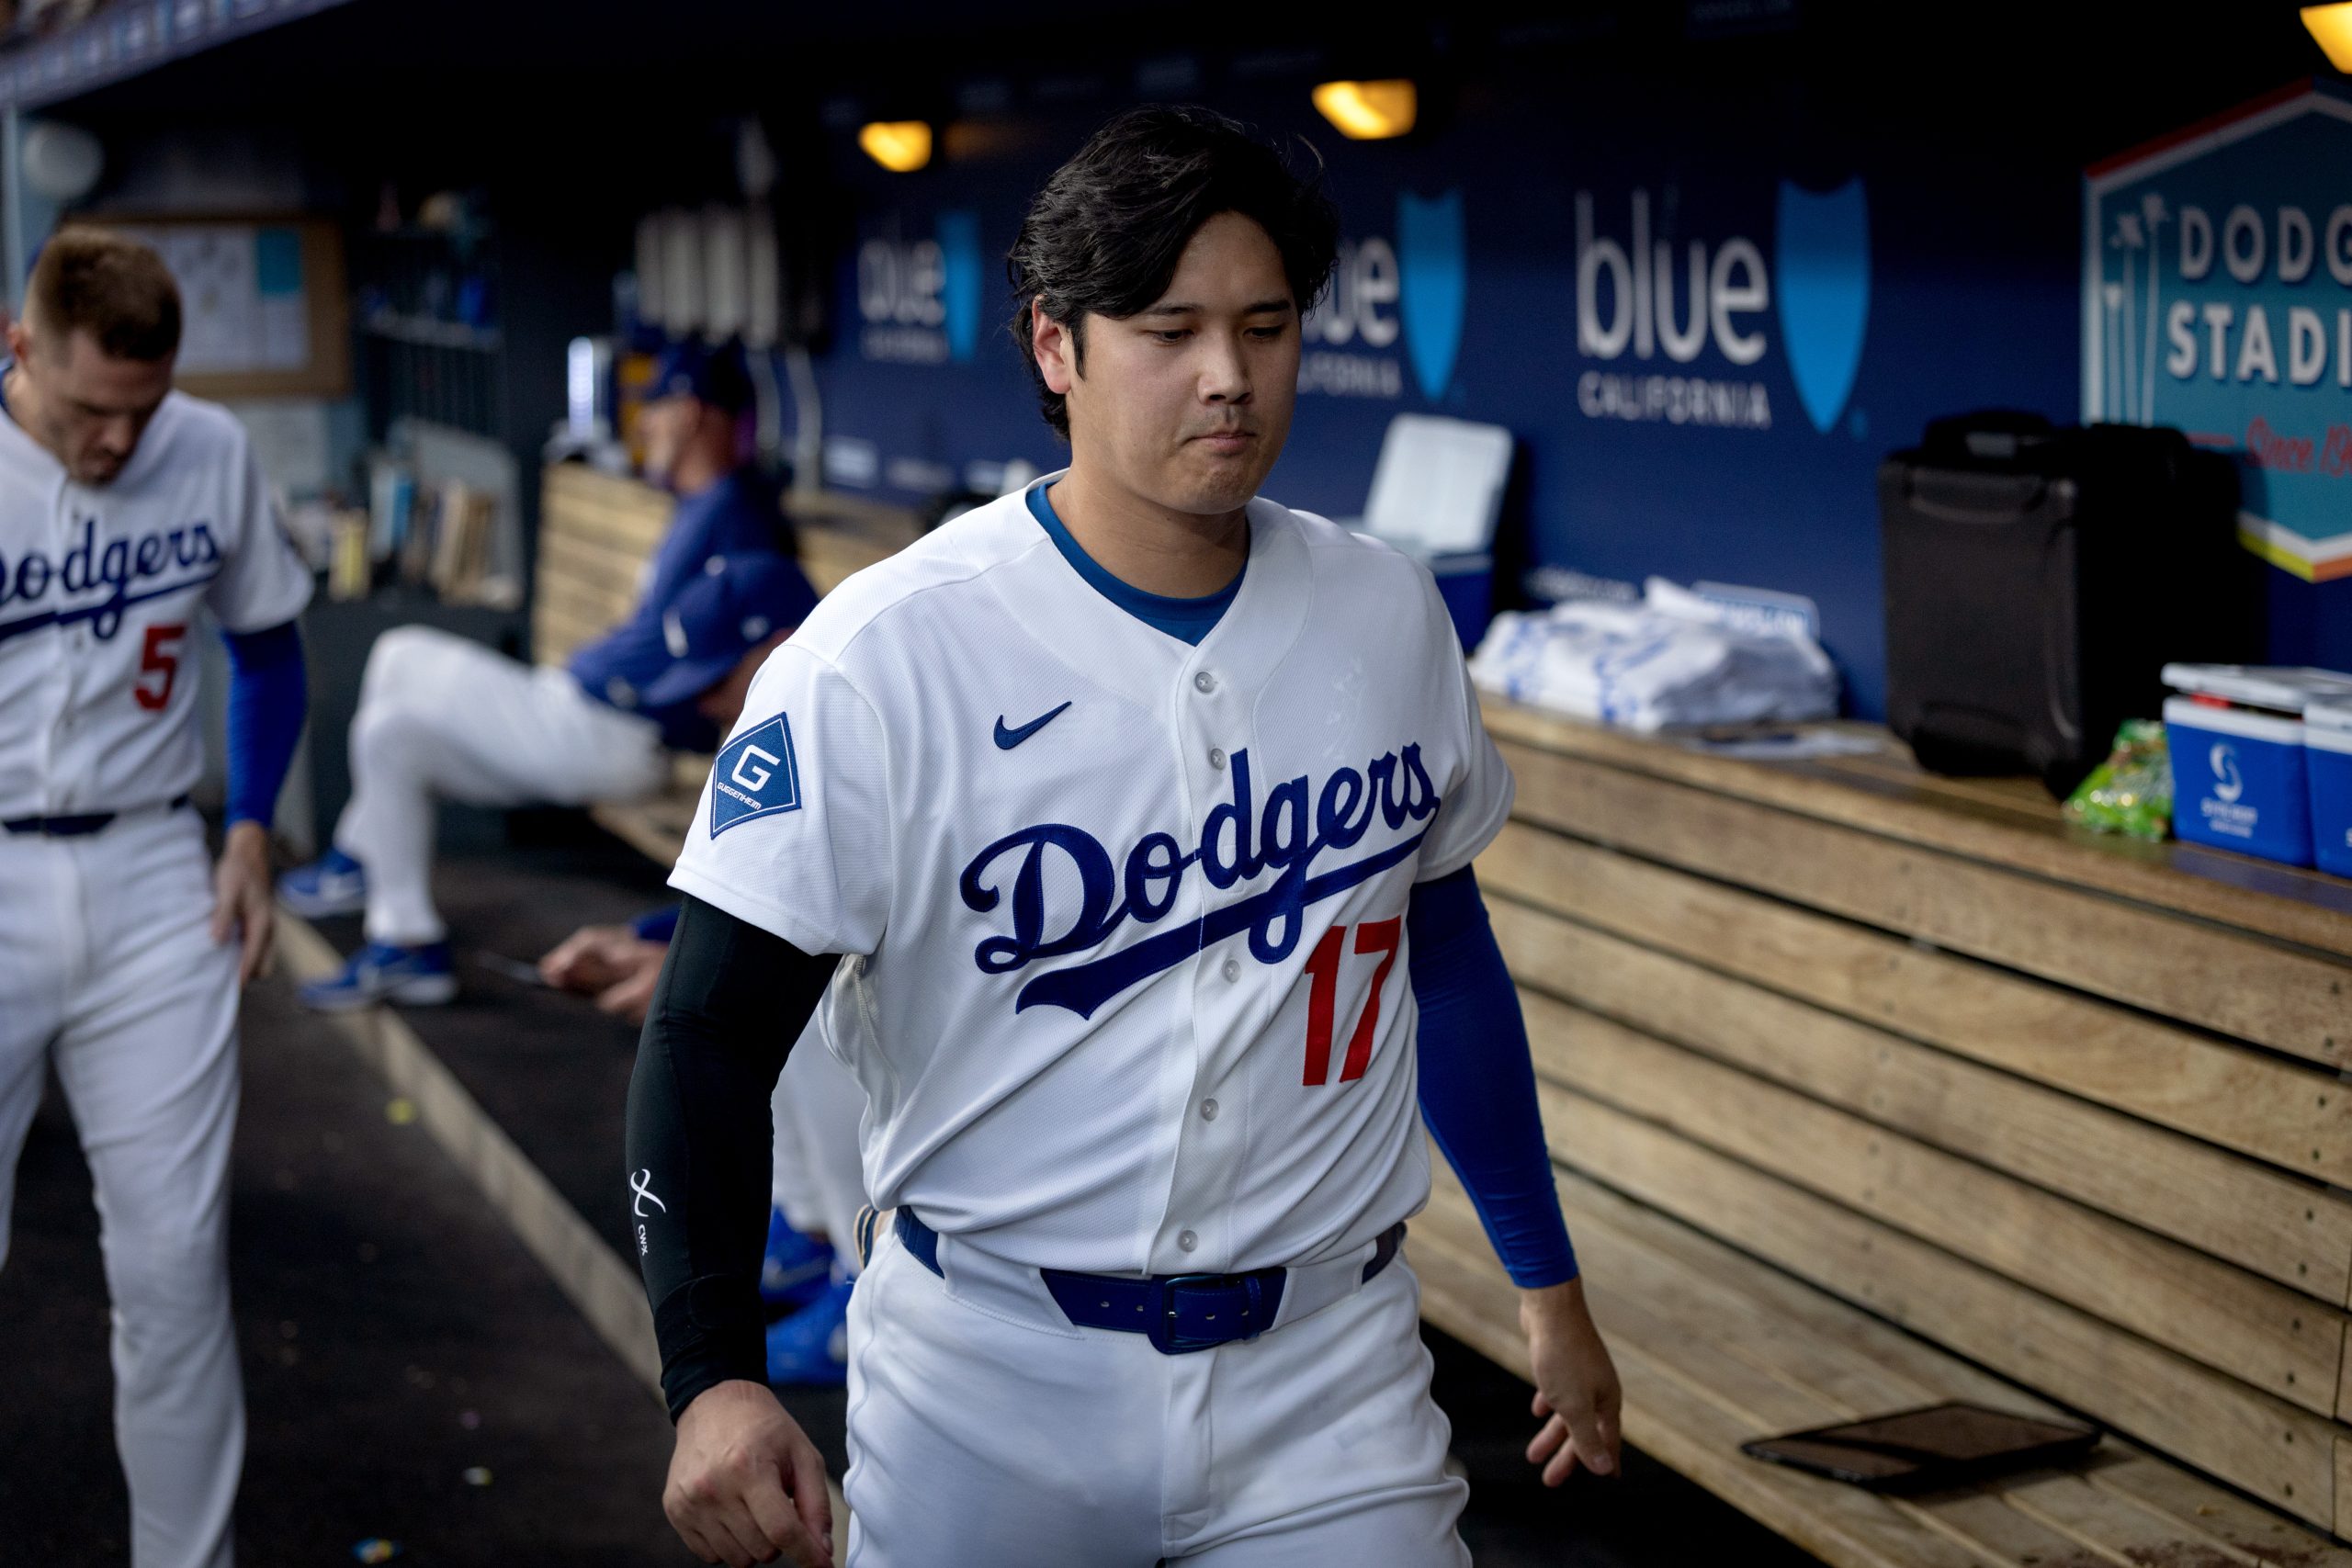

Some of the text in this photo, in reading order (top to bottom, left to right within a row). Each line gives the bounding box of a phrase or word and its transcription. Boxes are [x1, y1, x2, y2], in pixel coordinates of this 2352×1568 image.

[1576, 186, 1770, 366] blue
[1577, 372, 1772, 430] CALIFORNIA
[0, 517, 222, 640] odgers
[135, 625, 186, 710] 5
[717, 782, 762, 810] GUGGENHEIM
[732, 745, 781, 792] G
[960, 741, 1442, 975] Dodgers
[1302, 915, 1401, 1087] 17
[638, 1224, 649, 1256] CW-X
